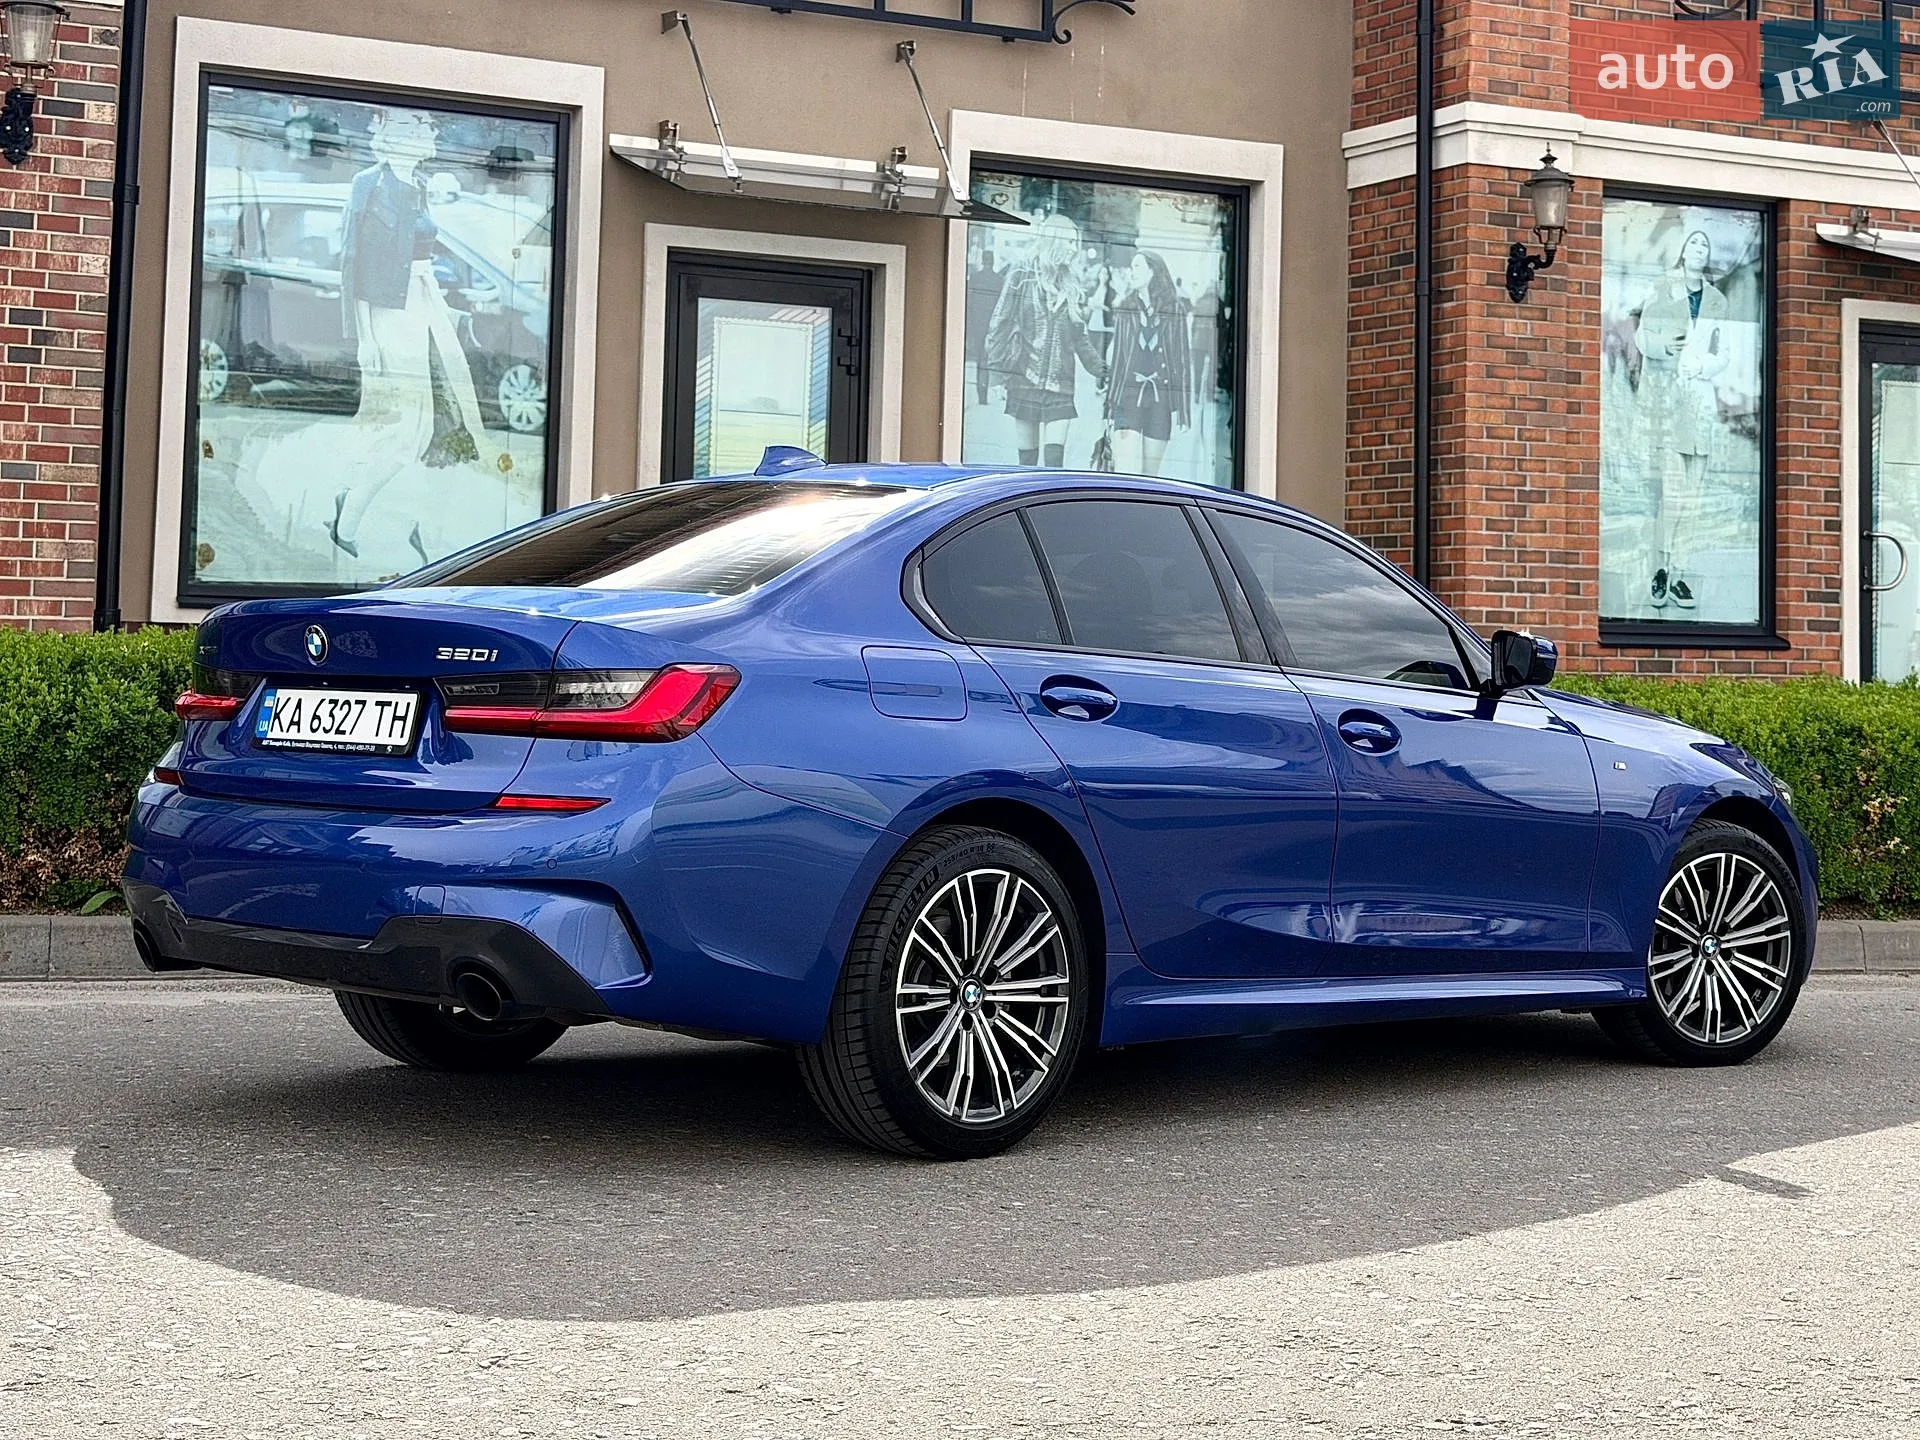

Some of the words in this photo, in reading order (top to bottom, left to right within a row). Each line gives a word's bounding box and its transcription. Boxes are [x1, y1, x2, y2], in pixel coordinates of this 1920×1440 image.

[436, 647, 499, 662] 320i
[258, 720, 268, 732] UA
[270, 697, 303, 734] KA
[309, 698, 367, 736] 6327
[375, 700, 411, 739] TH
[885, 868, 938, 962] MICHELIN
